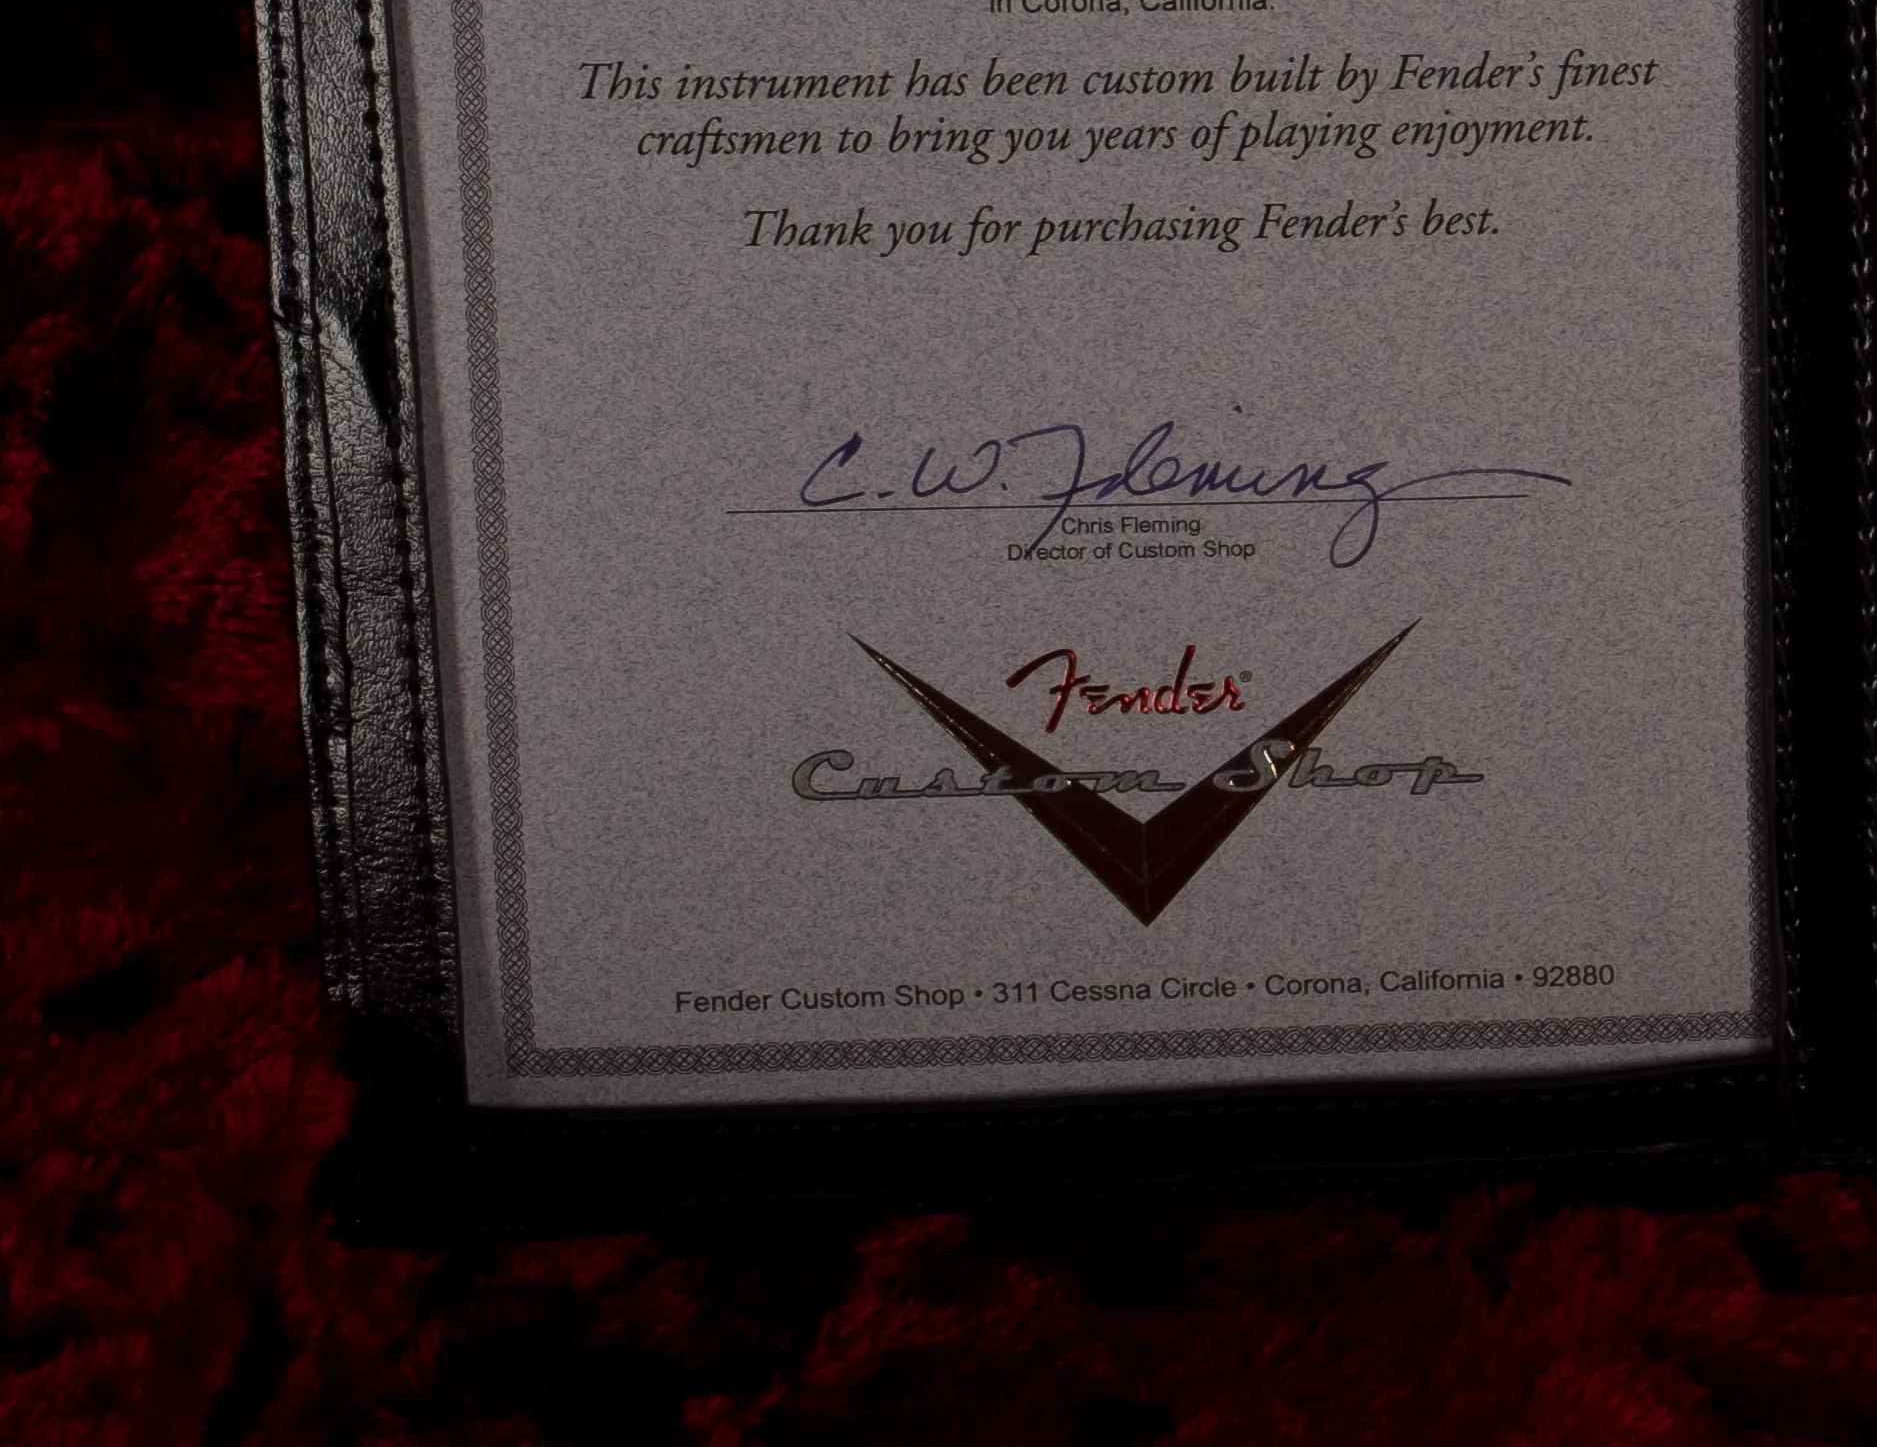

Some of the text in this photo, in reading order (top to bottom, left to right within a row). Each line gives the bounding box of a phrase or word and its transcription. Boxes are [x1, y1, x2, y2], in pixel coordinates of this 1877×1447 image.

[580, 61, 661, 99] This
[677, 64, 892, 99] instrument
[906, 59, 967, 96] has
[983, 58, 1067, 95] been
[1083, 68, 1213, 95] custom
[1231, 54, 1322, 92] built
[1337, 53, 1378, 103] by
[1556, 49, 1659, 100] finest
[638, 111, 1592, 168] craftsmen to bring you years of playing enjoyment.
[745, 208, 872, 246] Thank
[886, 216, 954, 259] you
[959, 206, 1021, 256] for
[1028, 203, 1243, 255] purchasing
[1423, 198, 1498, 235] best.
[1007, 543, 1087, 561] Director
[1118, 541, 1196, 561] Custom
[1204, 541, 1255, 559] Shop
[1061, 516, 1201, 536] Chris Fleming
[791, 741, 1484, 803] Custom Shop
[676, 965, 1614, 1012] Fender Custom Shop 311 Cessna Circle Corona, California 92880
